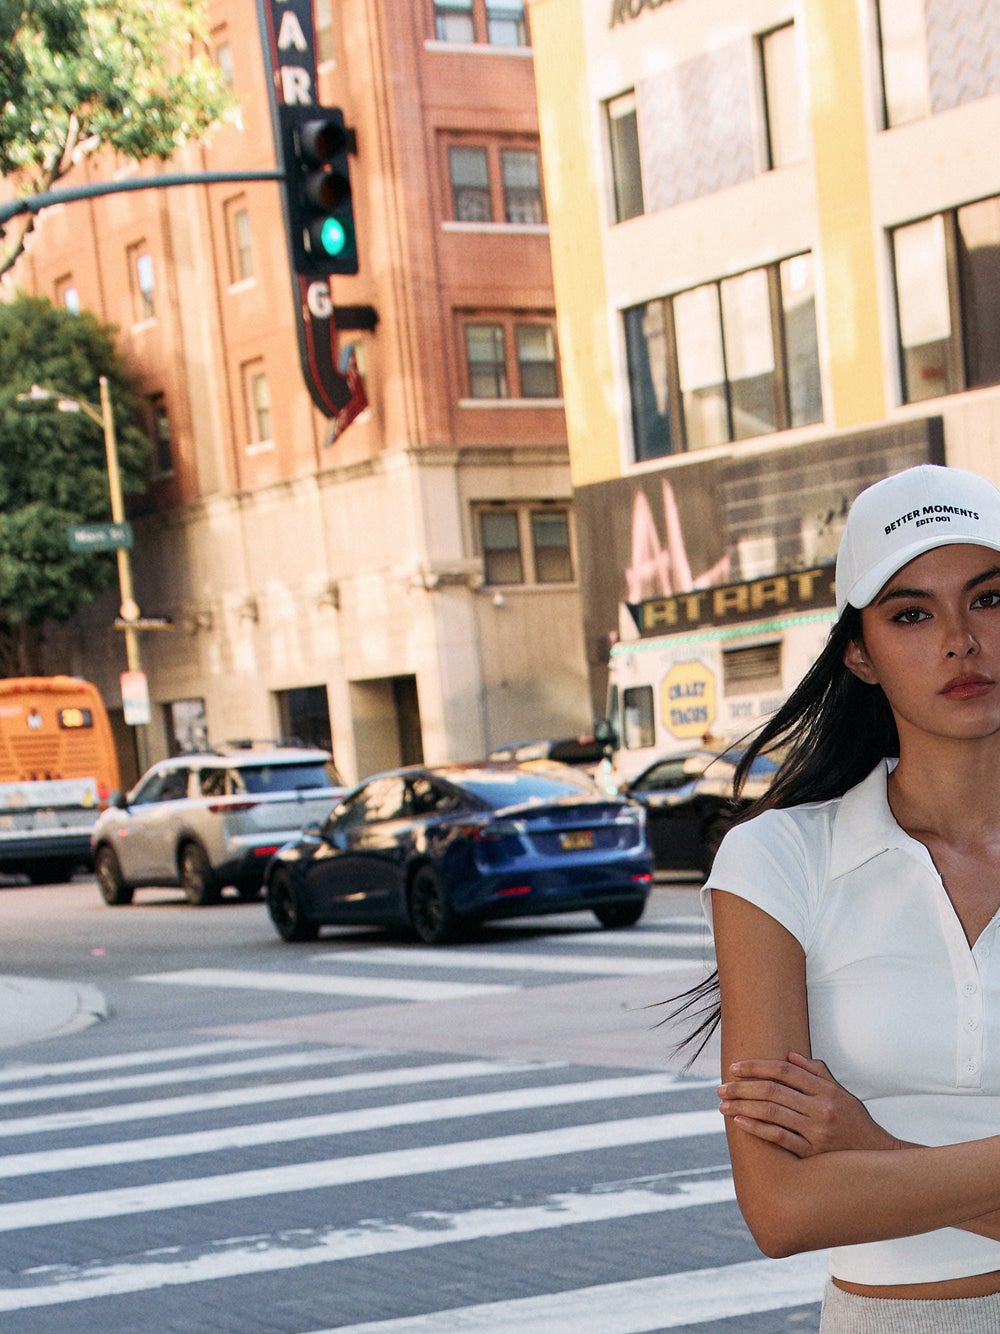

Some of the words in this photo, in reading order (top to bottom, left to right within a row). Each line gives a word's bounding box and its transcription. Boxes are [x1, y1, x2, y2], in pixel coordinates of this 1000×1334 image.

[885, 509, 920, 535] BETTER
[922, 505, 980, 520] MOMENTS
[916, 517, 934, 527] EDIT
